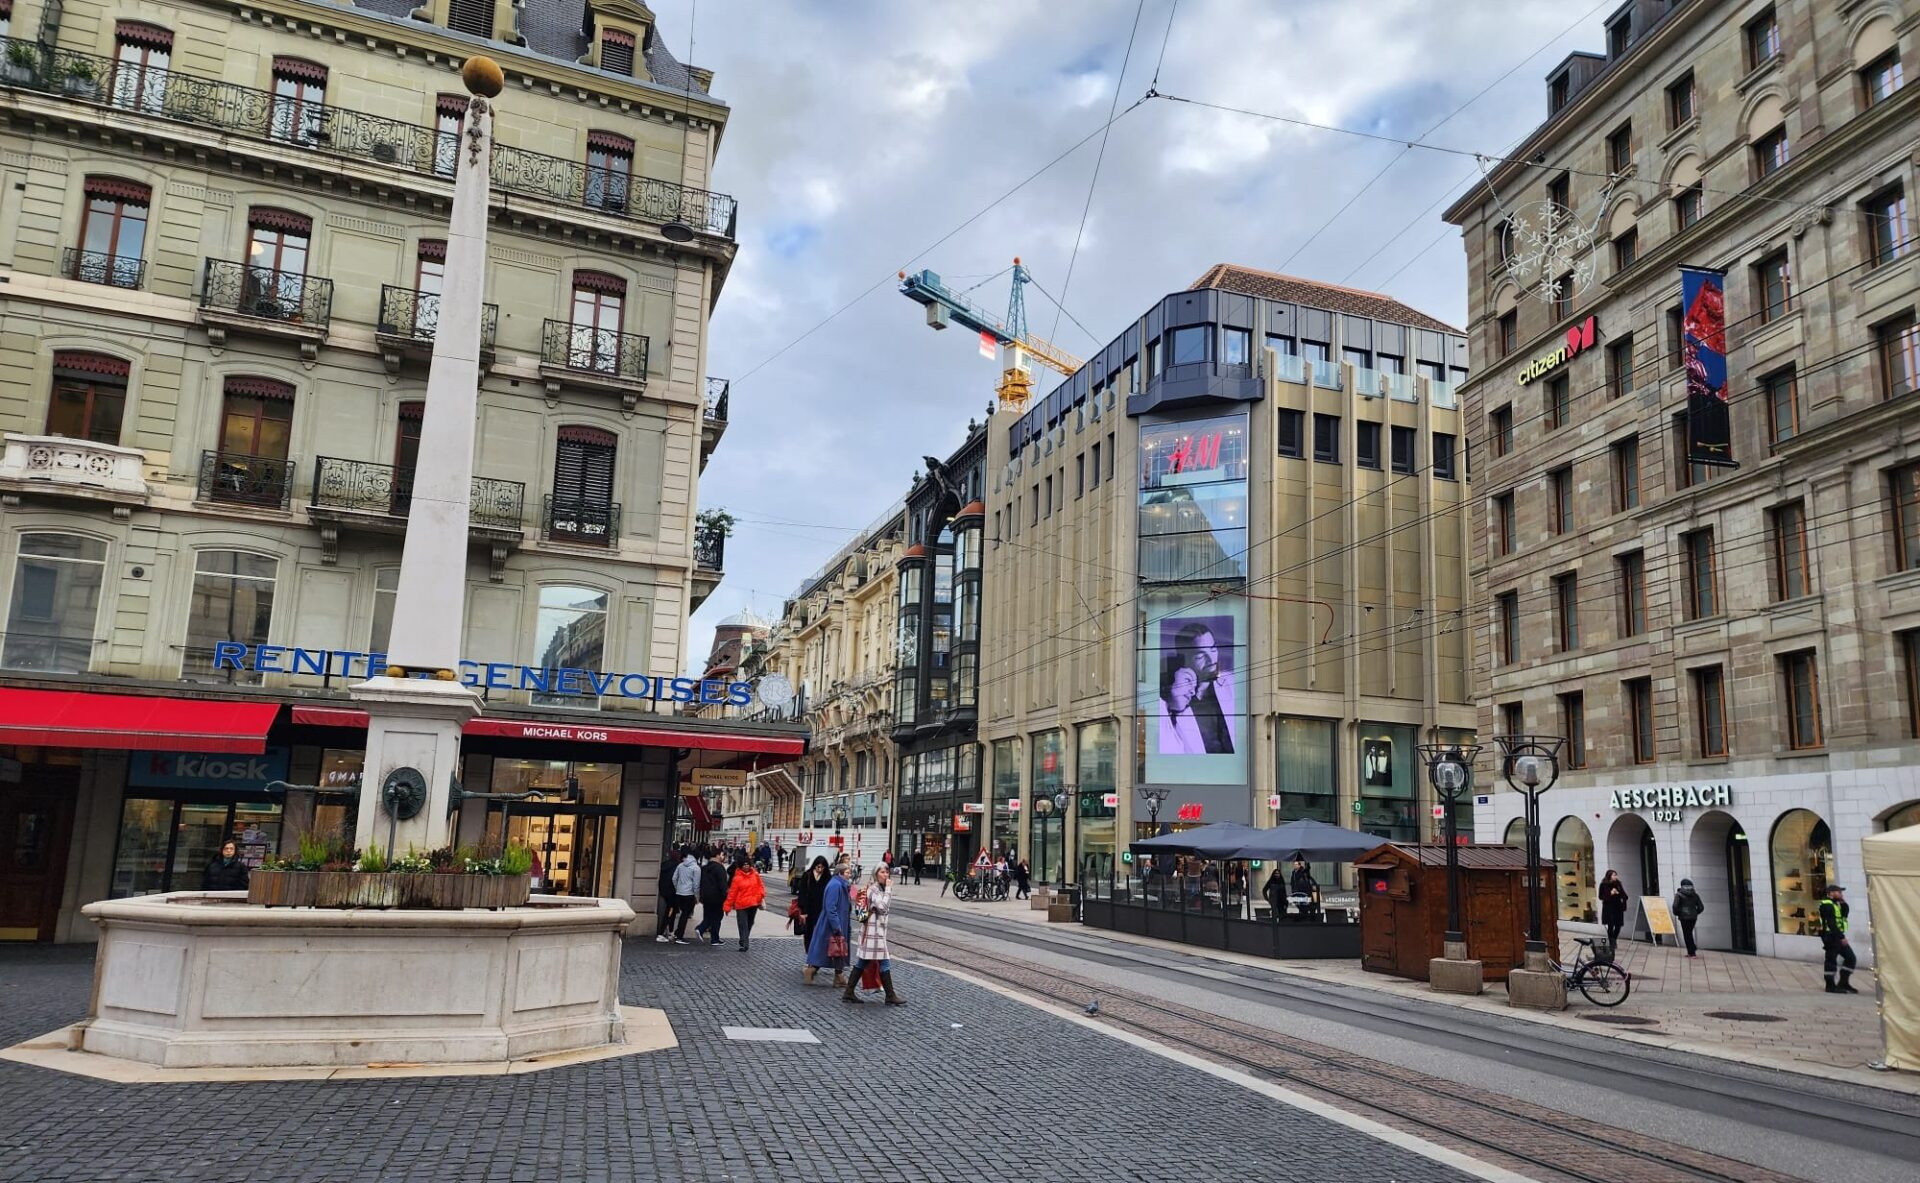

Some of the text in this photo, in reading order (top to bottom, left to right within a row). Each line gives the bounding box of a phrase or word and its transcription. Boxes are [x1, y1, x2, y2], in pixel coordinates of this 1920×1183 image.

[1518, 315, 1595, 385] citizenM
[1167, 432, 1222, 473] H&M
[459, 659, 752, 706] GENEVOISES
[522, 726, 608, 741] MICHAEL KORS
[175, 755, 270, 780] kiosk
[1609, 784, 1730, 809] AESCHBACH
[1650, 809, 1682, 822] 1904
